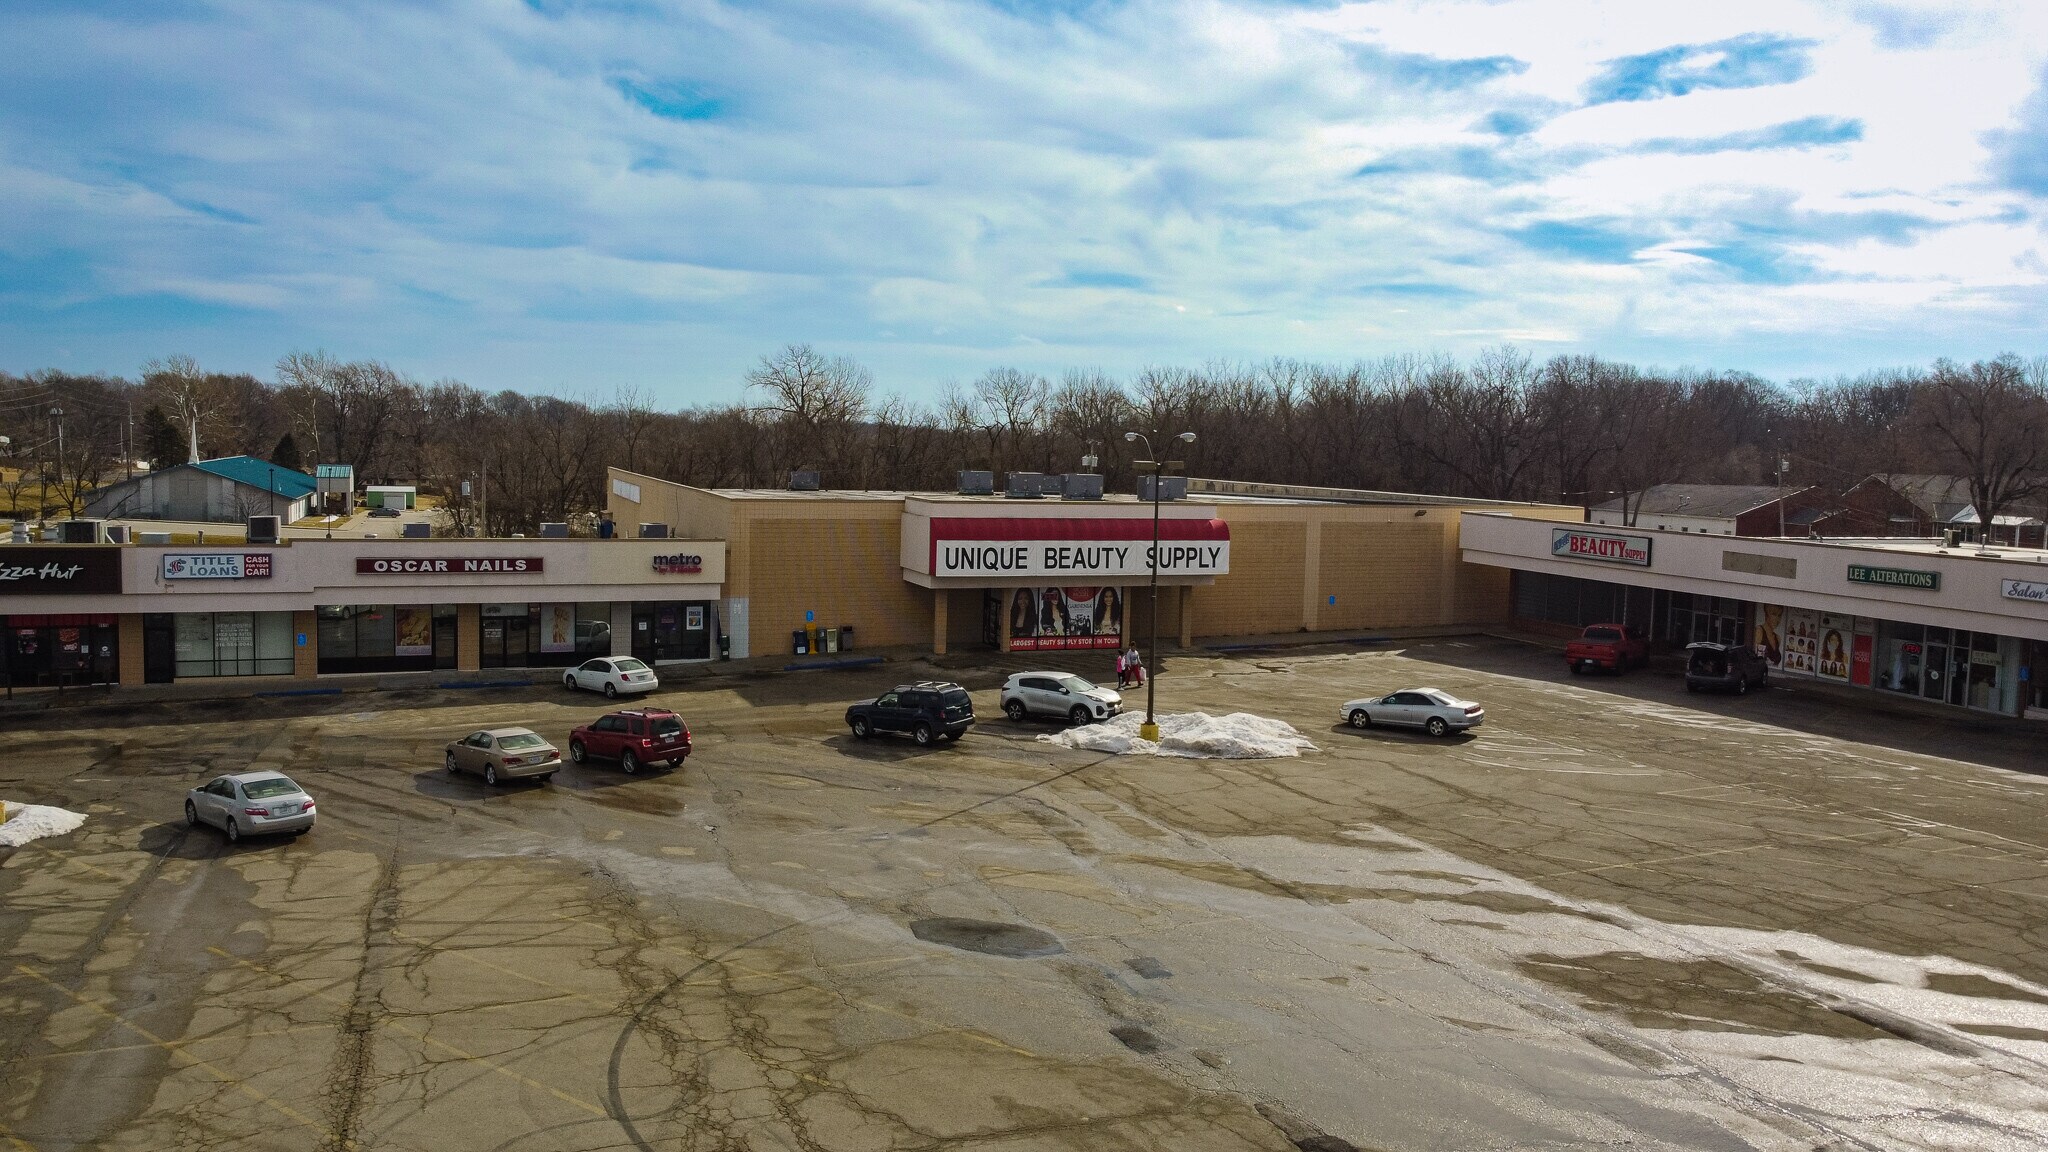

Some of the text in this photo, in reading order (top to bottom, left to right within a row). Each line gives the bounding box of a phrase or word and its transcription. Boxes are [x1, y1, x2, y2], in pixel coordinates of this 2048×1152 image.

[1570, 536, 1627, 557] BEAUTY
[191, 556, 235, 565] TITLE
[653, 553, 702, 565] metro
[945, 546, 1221, 571] UNIQUE BEAUTY SUPPLY
[1625, 549, 1646, 560] SUPPLY
[39, 562, 84, 580] Hut
[190, 565, 239, 576] LOANS
[245, 568, 269, 576] CAR!
[374, 559, 527, 572] OSCAR NAILS
[1849, 567, 1932, 587] LEE ALTERATIONS
[2007, 582, 2045, 600] Salon
